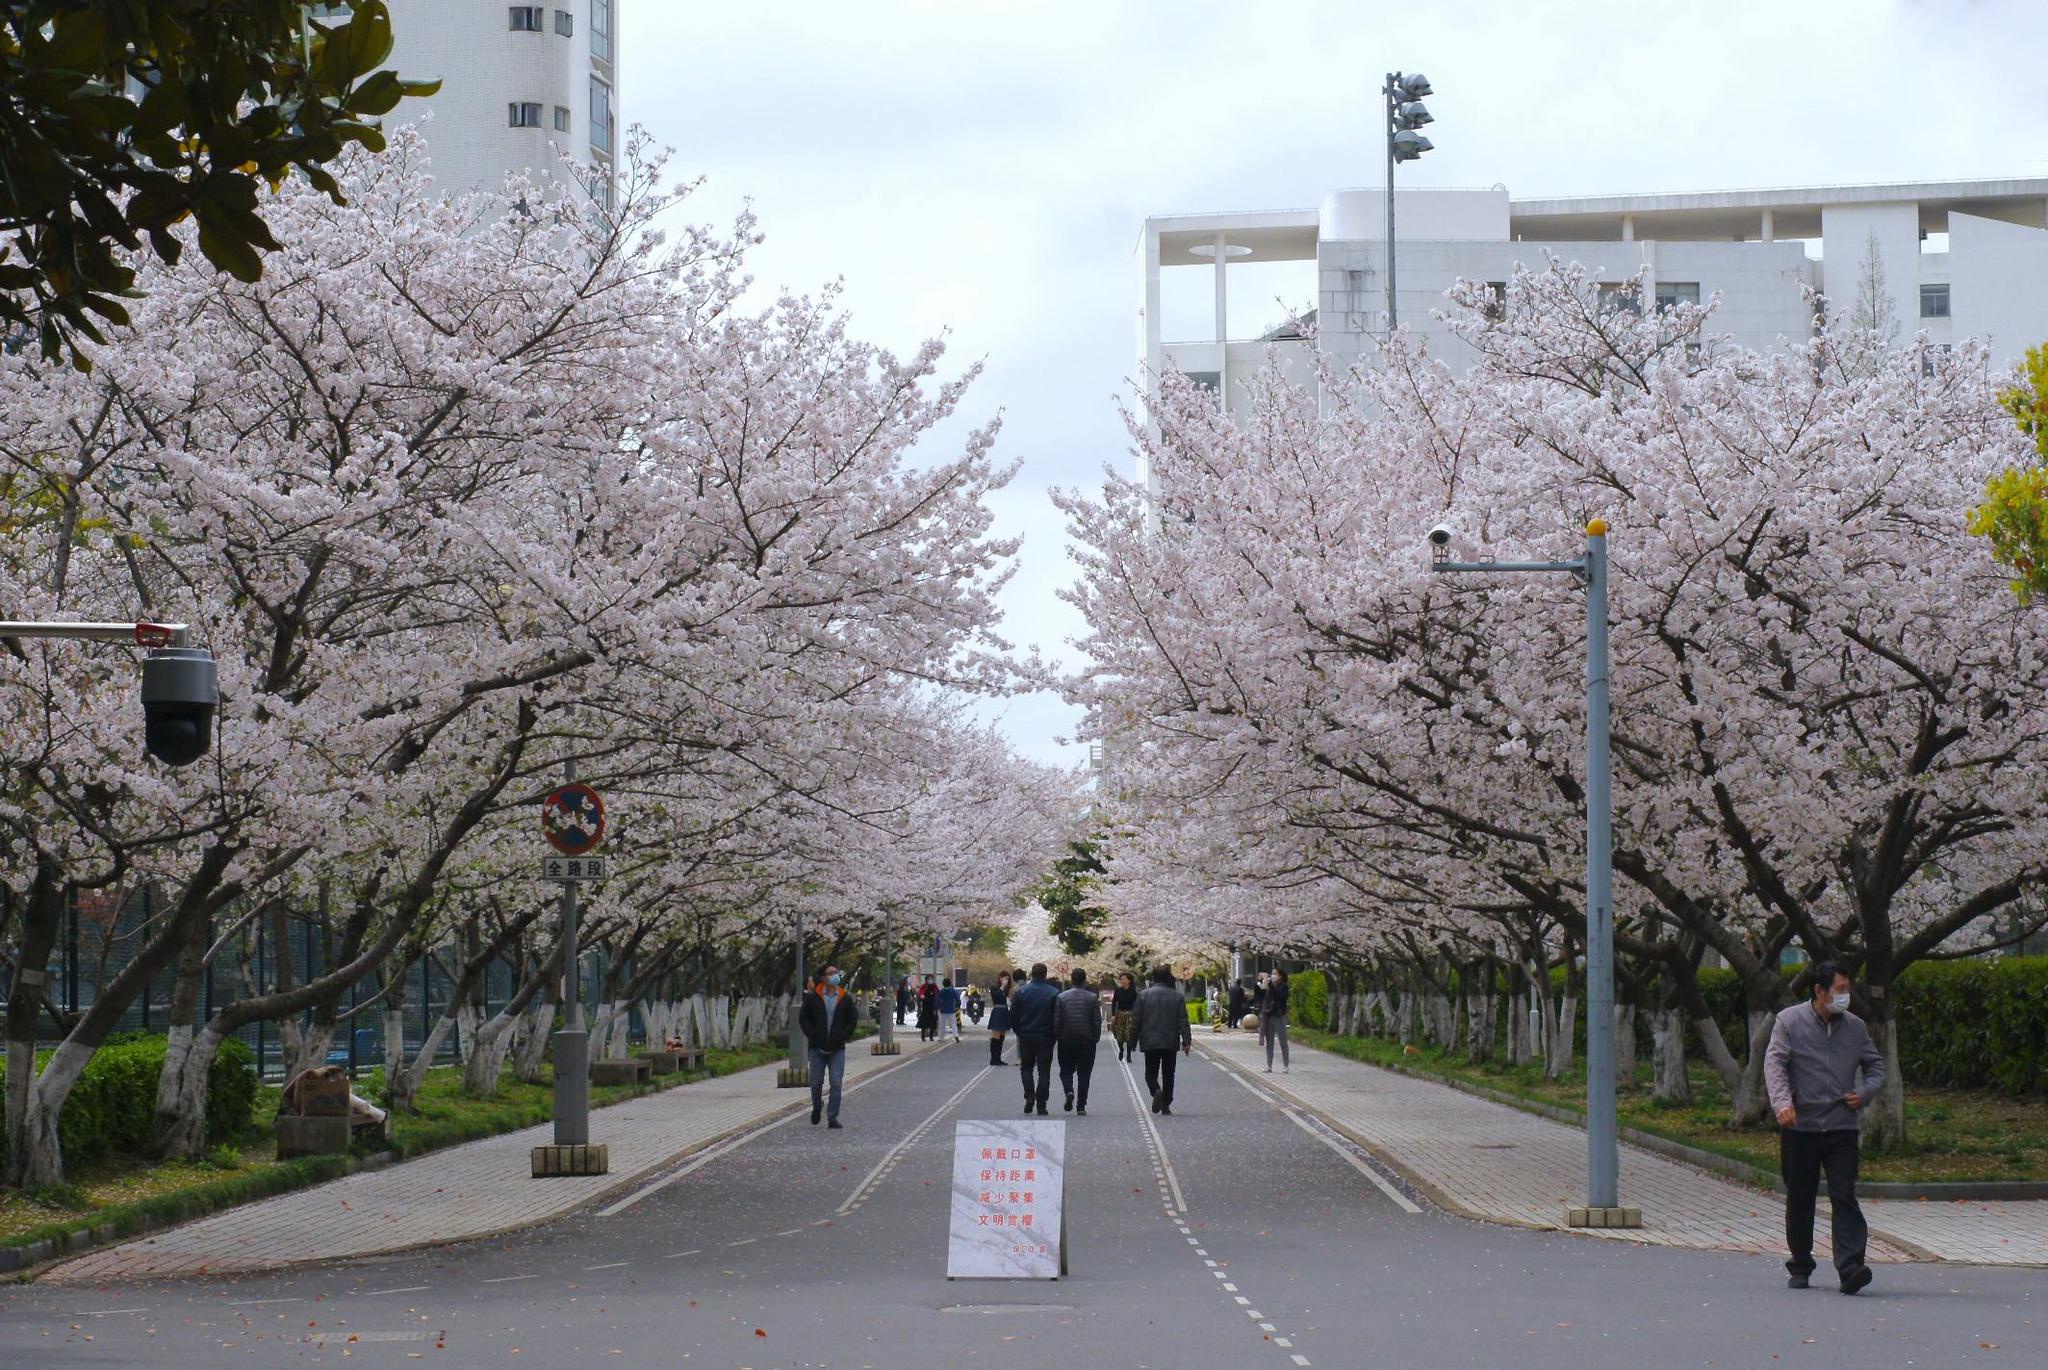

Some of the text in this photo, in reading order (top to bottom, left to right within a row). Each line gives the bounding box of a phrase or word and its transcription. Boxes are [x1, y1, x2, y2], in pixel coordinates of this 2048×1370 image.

[548, 860, 601, 876] 全路段
[981, 1147, 1036, 1160] 佩戴口罩
[981, 1169, 1035, 1182] 保持距离
[980, 1191, 1034, 1204] 减少聚集
[978, 1214, 1033, 1227] 文明赏樱
